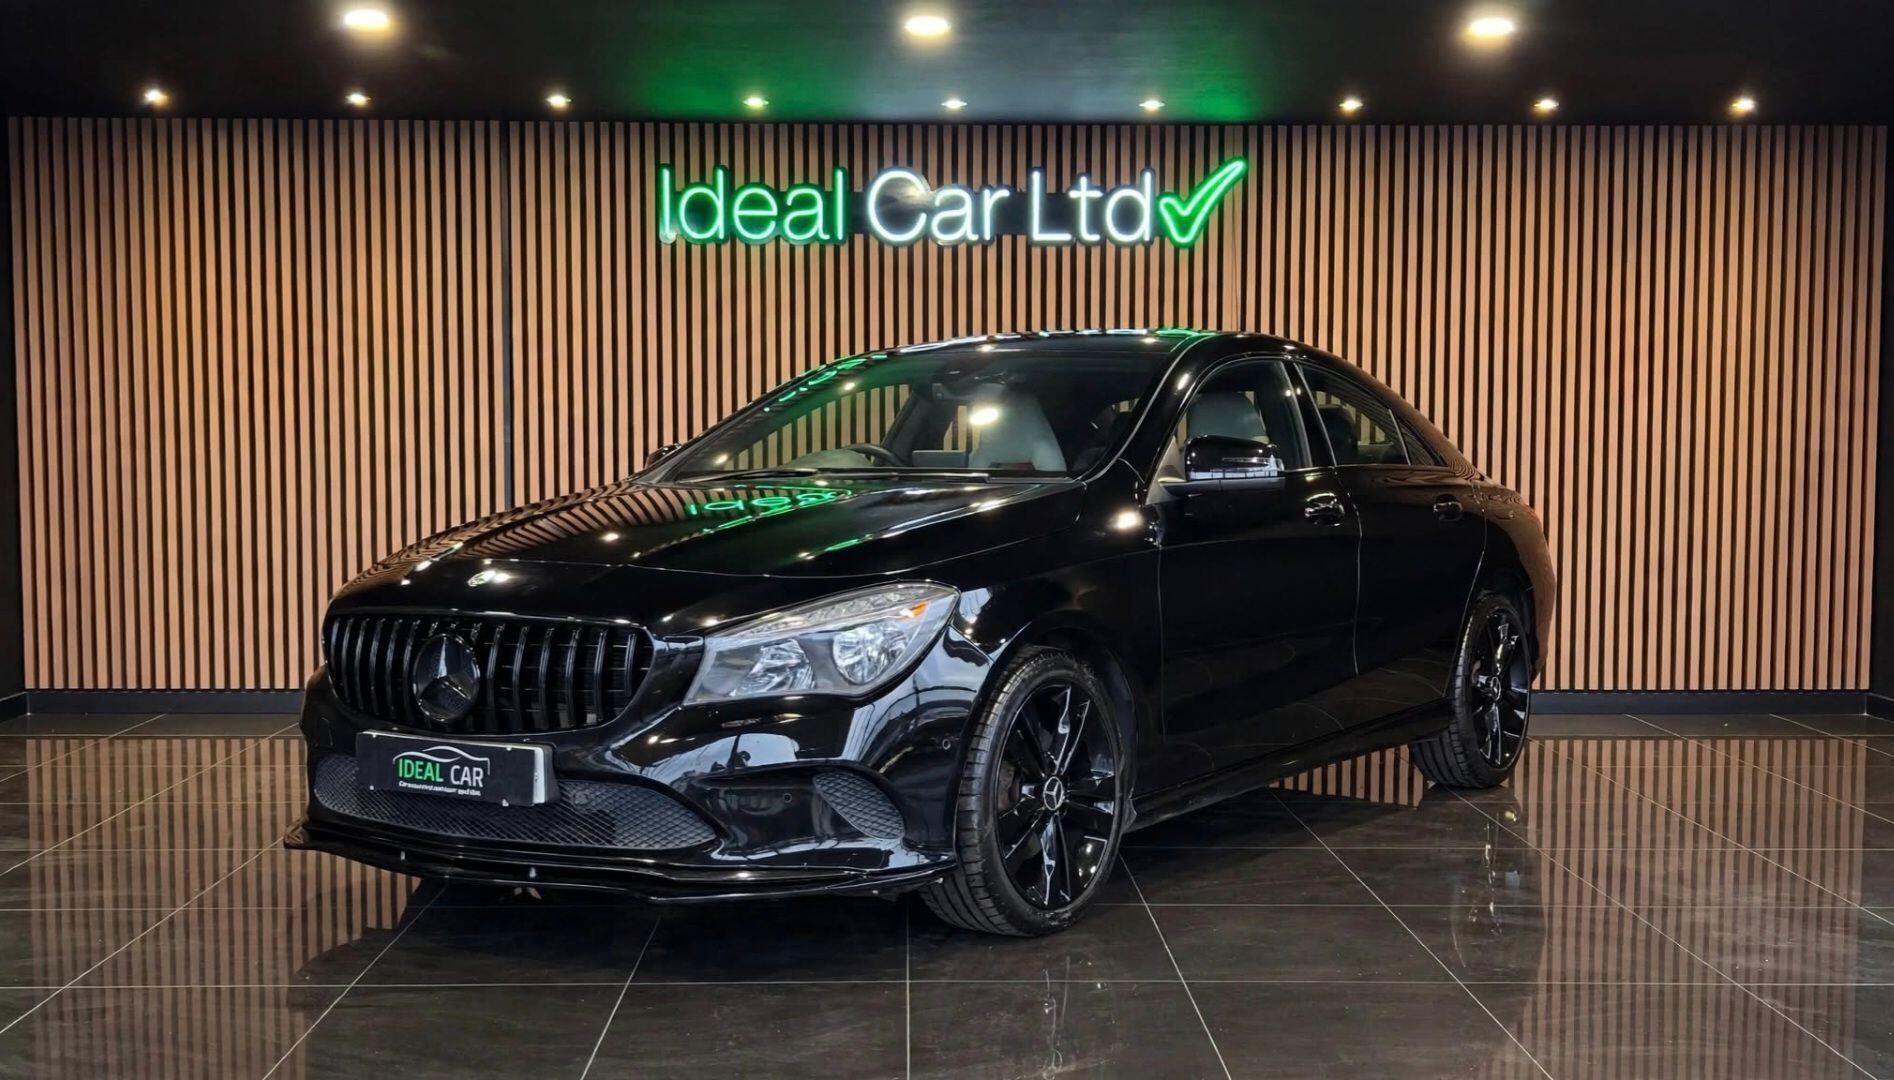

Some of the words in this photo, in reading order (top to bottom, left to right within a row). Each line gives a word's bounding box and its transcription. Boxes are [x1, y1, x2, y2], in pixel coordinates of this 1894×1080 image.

[660, 166, 846, 244] Ideal
[866, 167, 1010, 243] Car
[1031, 167, 1154, 243] Ltd
[398, 758, 444, 782] IDEAL
[450, 765, 484, 788] CAR
